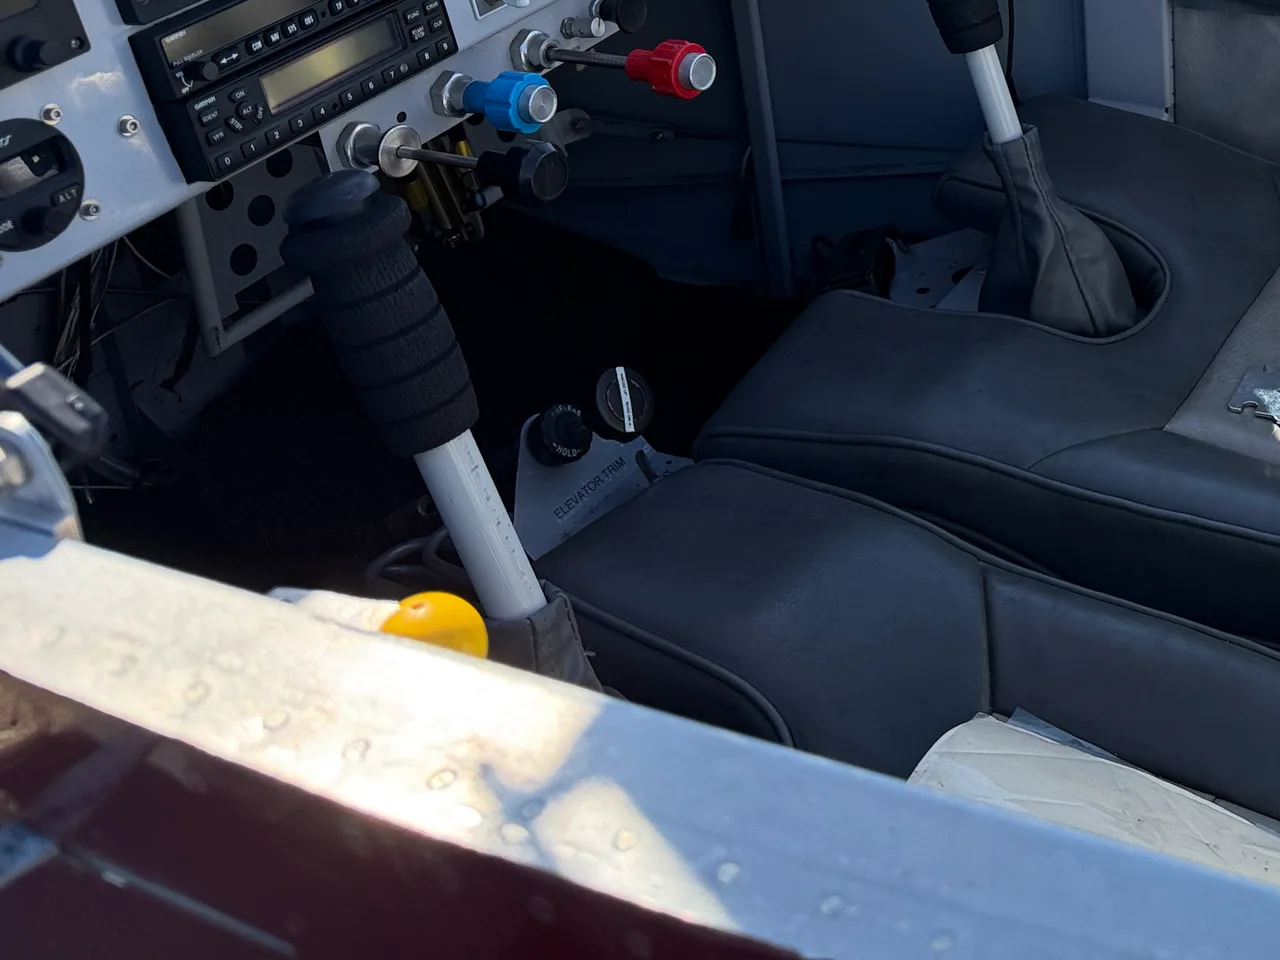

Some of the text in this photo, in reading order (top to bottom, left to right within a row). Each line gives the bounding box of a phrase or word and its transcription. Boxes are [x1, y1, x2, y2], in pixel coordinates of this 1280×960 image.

[407, 10, 420, 20] FUNC
[287, 23, 297, 33] SYS
[433, 20, 443, 28] CLR
[442, 42, 448, 50] 9
[424, 52, 430, 60] 8
[390, 71, 395, 79] 7
[368, 81, 374, 89] 6
[235, 90, 245, 99] ON
[347, 92, 353, 100] 5
[194, 96, 216, 110] GARMIN
[242, 106, 253, 115] ALT
[320, 107, 325, 115] 4
[202, 110, 218, 123] IDENT
[297, 119, 303, 127] 3
[213, 132, 225, 141] VFR
[274, 131, 280, 139] 2
[250, 144, 256, 152] 1
[224, 157, 231, 165] 0
[59, 188, 77, 203] ALT
[0, 220, 14, 234] ODE
[556, 445, 578, 458] HOLD
[553, 456, 627, 519] ELEVATOR TRIM
